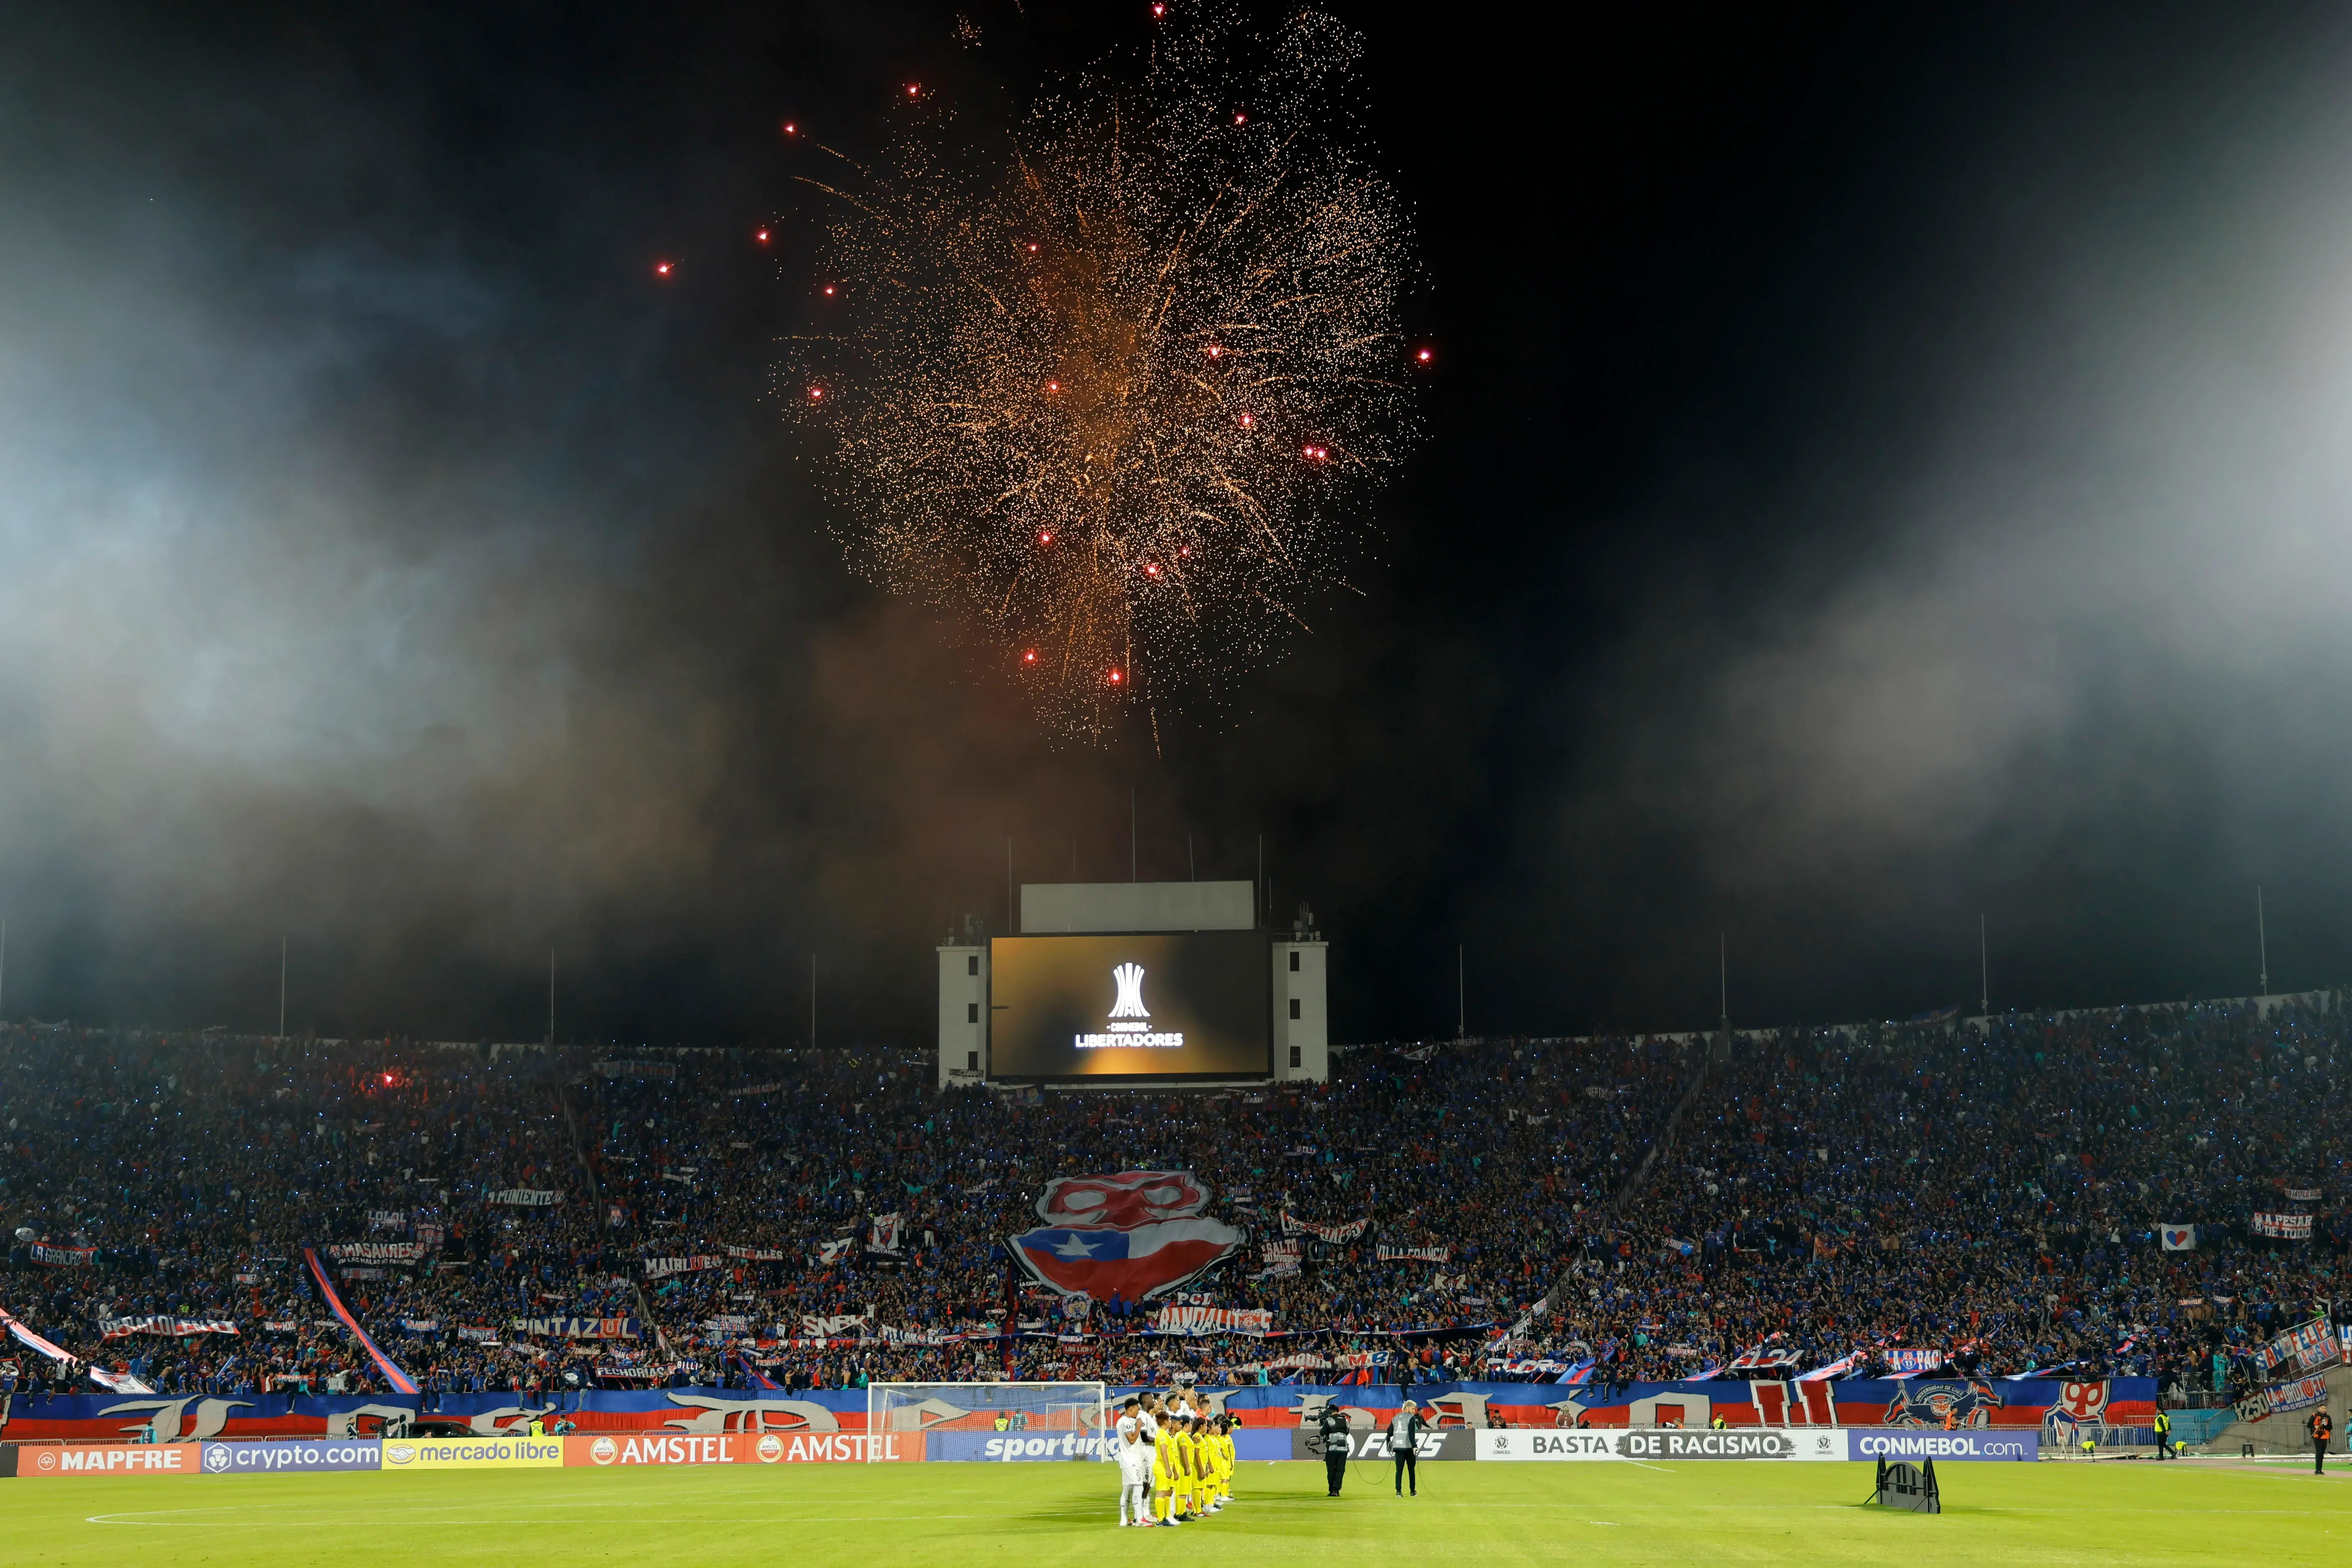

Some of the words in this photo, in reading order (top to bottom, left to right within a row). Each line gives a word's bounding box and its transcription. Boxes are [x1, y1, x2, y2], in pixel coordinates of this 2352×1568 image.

[1111, 1022, 1149, 1031] CONMEBOL
[1076, 1033, 1183, 1047] LIBERTADORES
[2265, 1214, 2272, 1225] A
[2275, 1214, 2312, 1227] PESAR
[2265, 1225, 2278, 1237] DE
[2282, 1226, 2311, 1239] TODO
[30, 1244, 43, 1261] LA
[342, 1243, 414, 1259] MASAKRES
[729, 1245, 784, 1260] RITUALES
[1266, 1238, 1298, 1255] SALTO
[645, 1256, 712, 1274] MAIBLUE
[802, 1315, 870, 1338] SNBK
[2255, 1341, 2284, 1370] SAN
[2290, 1317, 2332, 1353] FELIPE
[1267, 1353, 1332, 1370] JOAQUIN
[1915, 1385, 1944, 1402] UNIVERSIDAD
[2264, 1388, 2280, 1406] LA
[2240, 1393, 2270, 1422] 250
[420, 1442, 511, 1461] mercado
[515, 1442, 559, 1459] libre
[621, 1437, 733, 1463] AMSTEL
[786, 1435, 900, 1461] AMSTEL
[1533, 1436, 1609, 1453] BASTA
[1631, 1436, 1661, 1453] DE
[1670, 1435, 1780, 1454] RACISMO
[1860, 1436, 2023, 1455] CONMEBOL.com
[61, 1450, 182, 1470] MAPFRE
[236, 1446, 379, 1468] crypto.com
